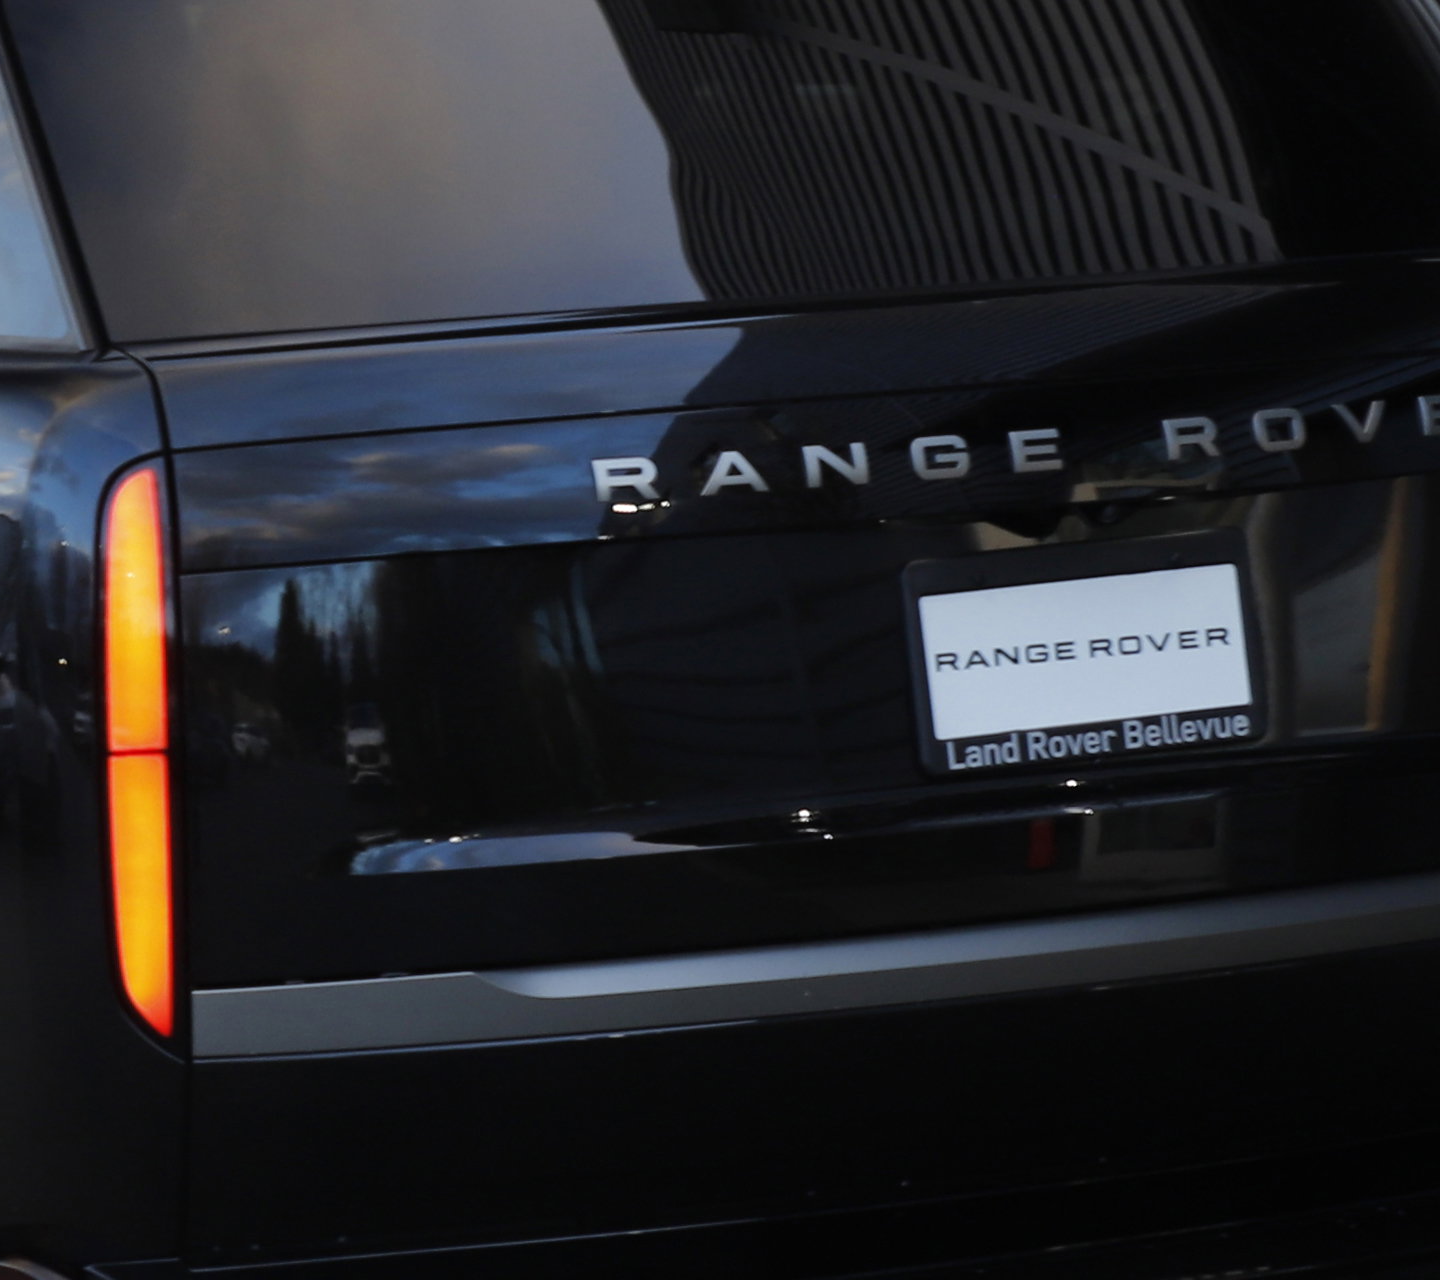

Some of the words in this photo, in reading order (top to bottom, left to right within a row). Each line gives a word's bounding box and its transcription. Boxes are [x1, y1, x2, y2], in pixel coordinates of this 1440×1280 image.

[590, 427, 1064, 503] RANGE
[934, 640, 1077, 671] RANGE
[1088, 626, 1231, 659] ROVER
[945, 732, 1021, 770] Land
[1026, 728, 1117, 761] Rover
[1122, 713, 1251, 750] Bellevue
